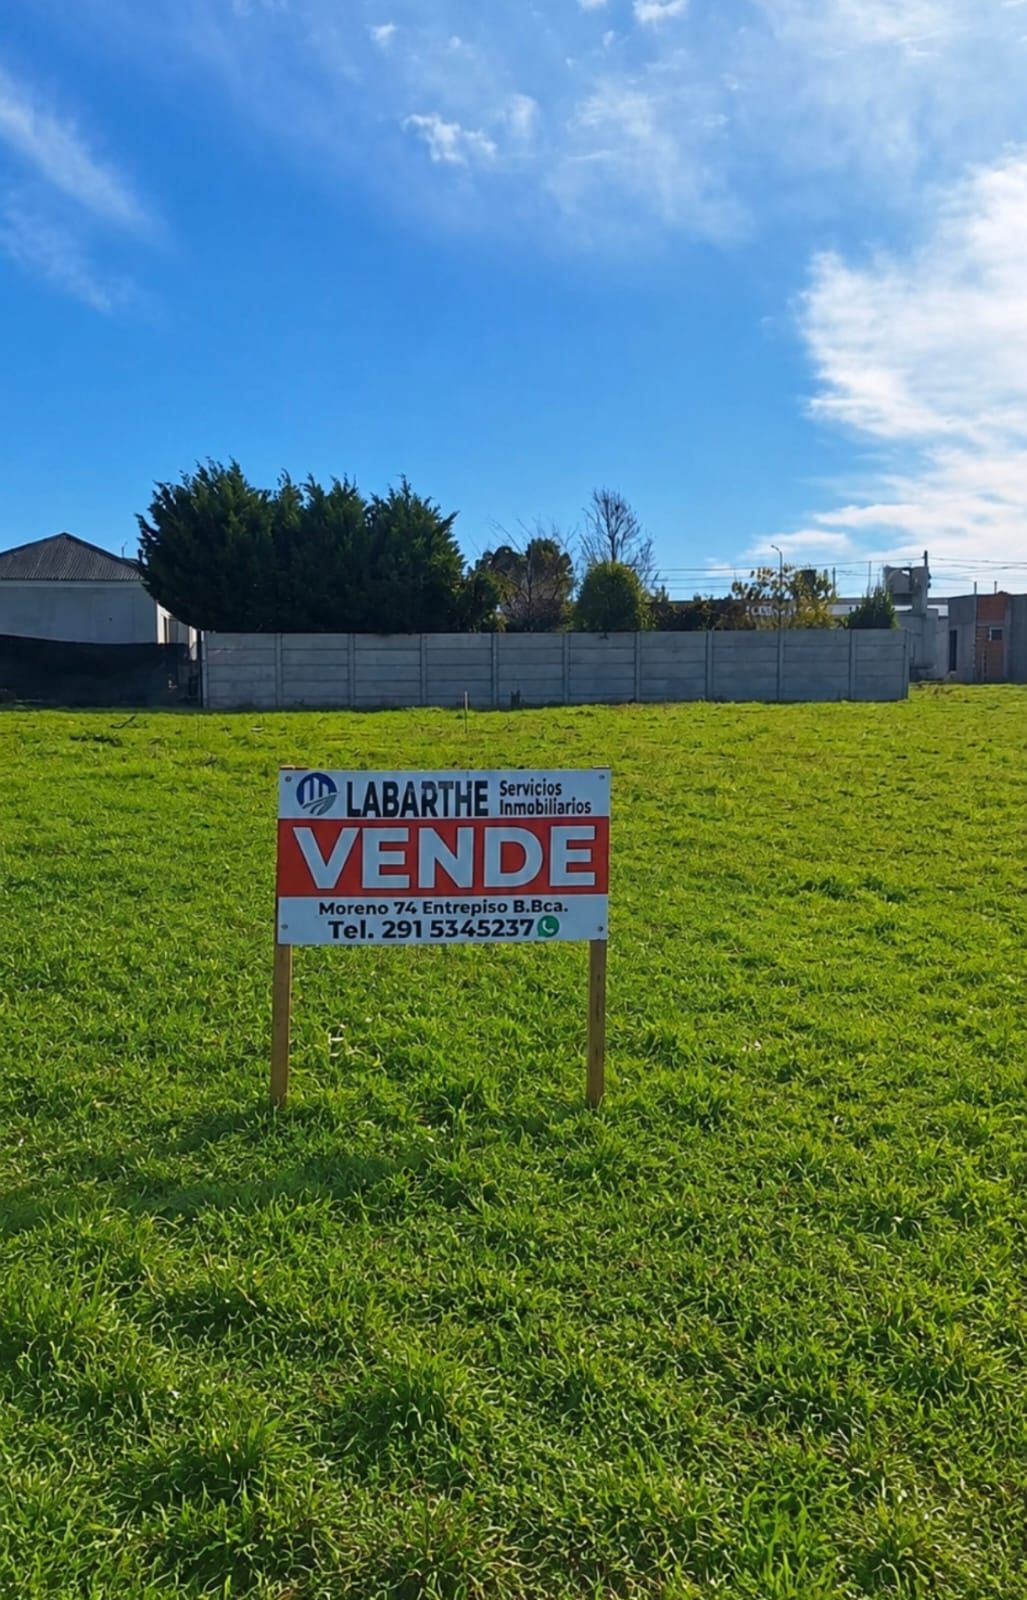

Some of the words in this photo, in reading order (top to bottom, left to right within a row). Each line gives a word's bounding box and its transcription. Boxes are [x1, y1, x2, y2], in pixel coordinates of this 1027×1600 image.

[500, 778, 562, 797] Servicios
[347, 780, 489, 817] LABARTHE
[500, 797, 592, 816] Inmobiliarios
[292, 826, 596, 889] VENDE
[319, 902, 389, 915] Moreno
[394, 902, 417, 914] 74
[423, 899, 508, 916] Entrepiso
[513, 900, 568, 913] B.Bca.
[328, 920, 374, 939] Tel.
[382, 920, 422, 939] 291
[430, 918, 535, 938] 5345237
